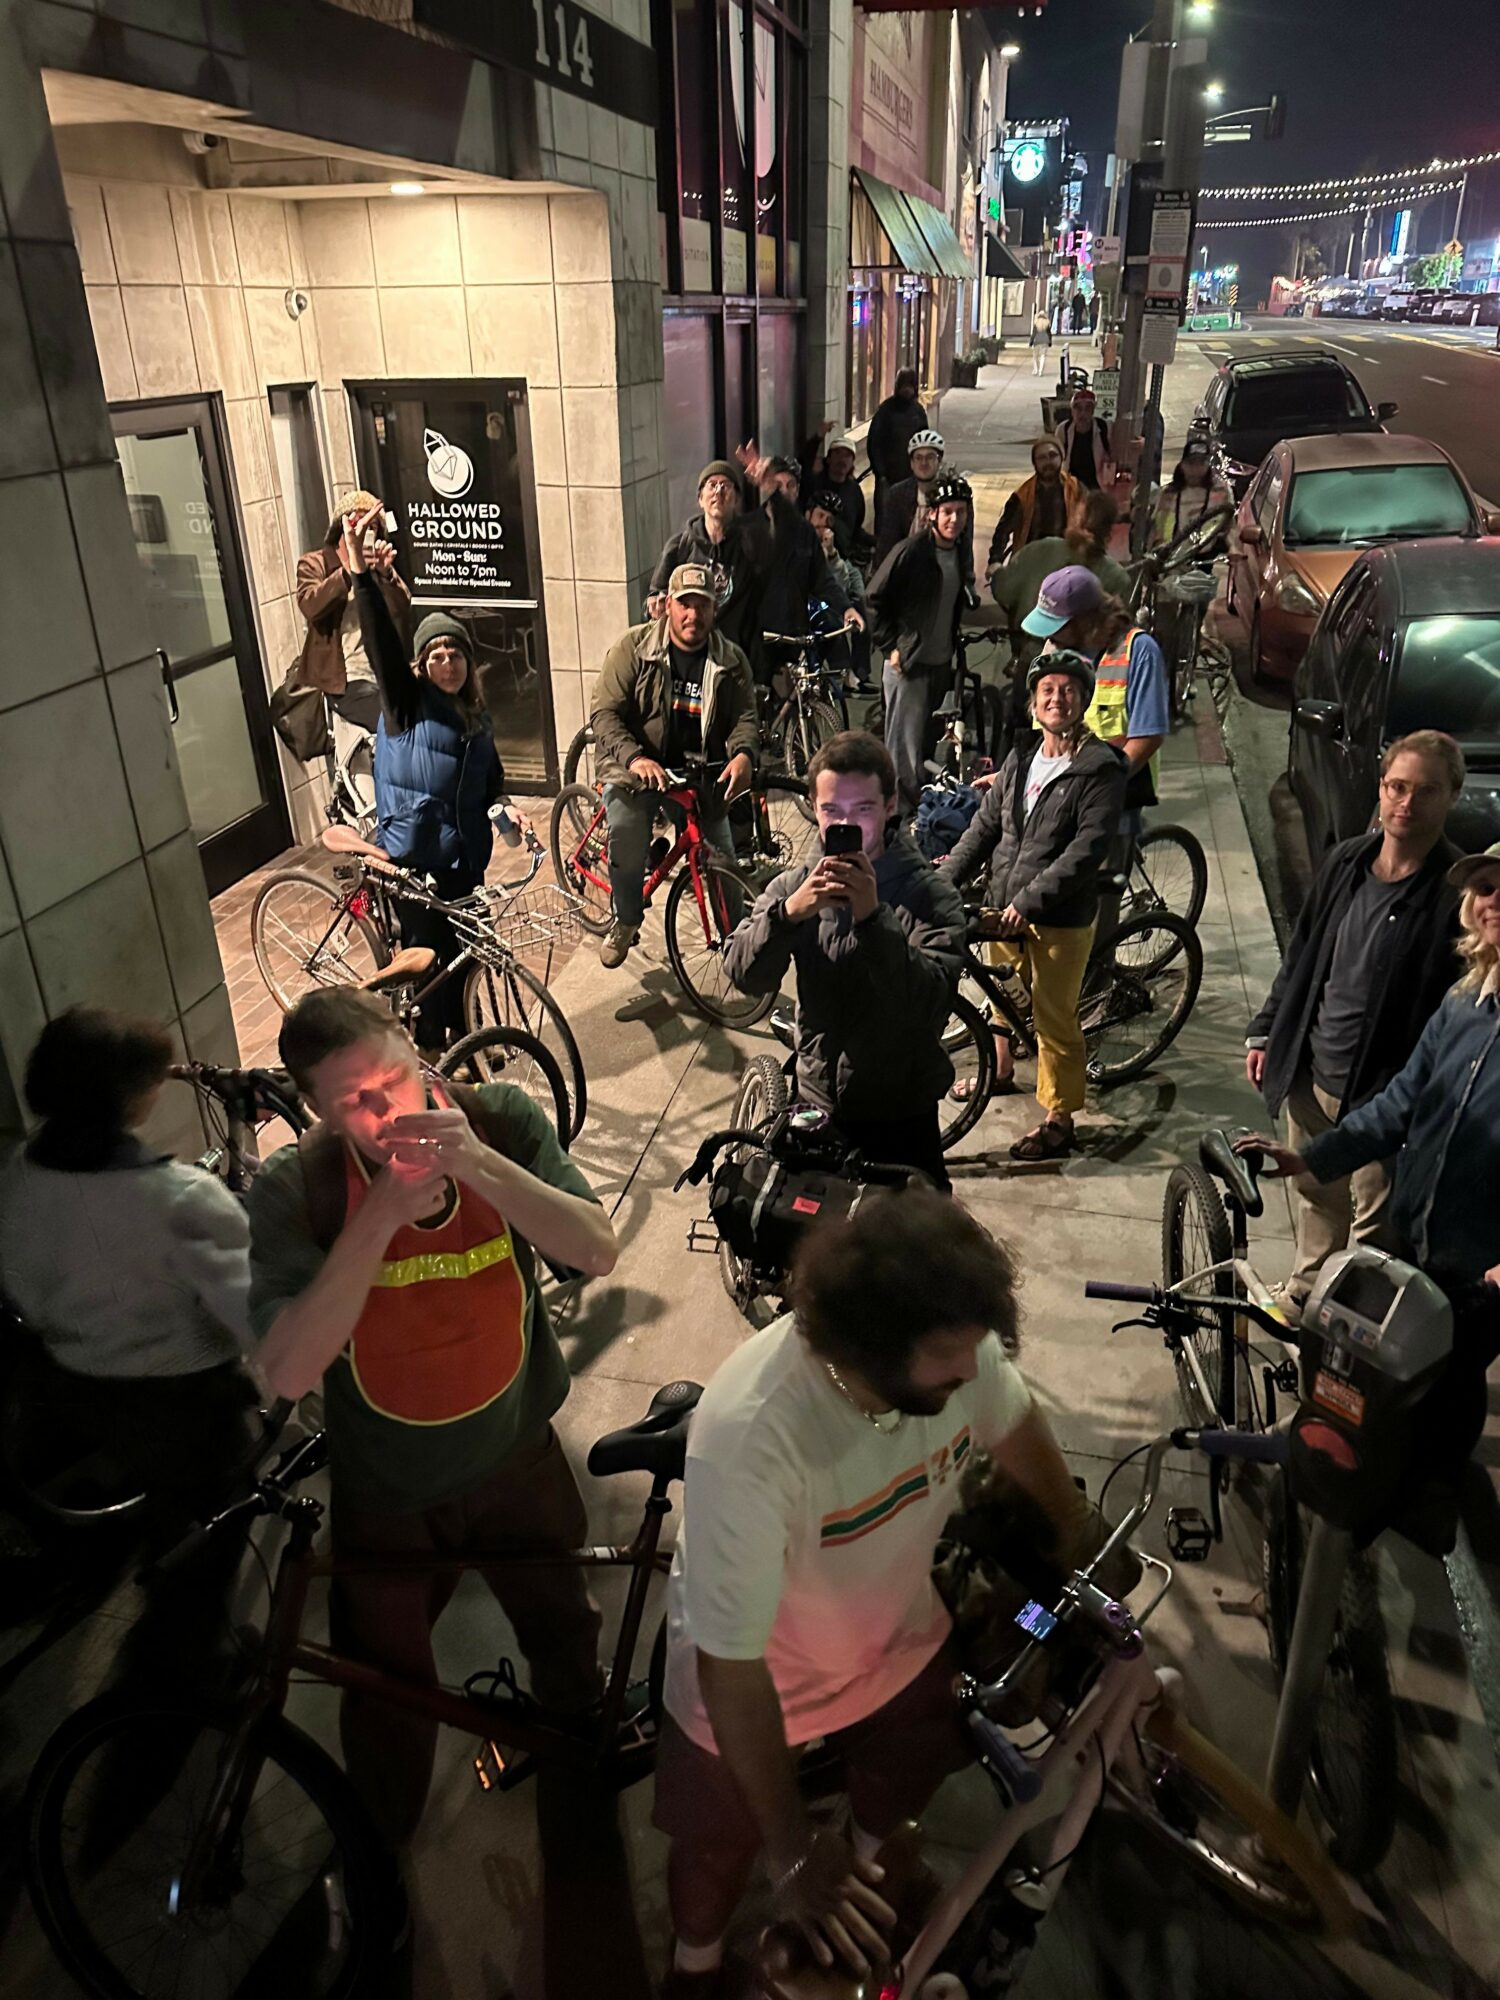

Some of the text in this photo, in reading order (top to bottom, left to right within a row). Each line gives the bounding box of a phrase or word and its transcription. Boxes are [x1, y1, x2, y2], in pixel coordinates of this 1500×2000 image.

[533, 0, 594, 88] 114
[870, 59, 913, 132] HAMBURGERS
[1102, 398, 1115, 407] $8
[408, 502, 500, 519] HALLOWED
[411, 520, 502, 540] GROUND
[432, 549, 456, 562] Mon
[425, 563, 497, 578] Noon to 7pm
[432, 577, 458, 586] Available
[459, 578, 469, 586] For
[469, 578, 490, 587] Special
[491, 579, 512, 588] Events
